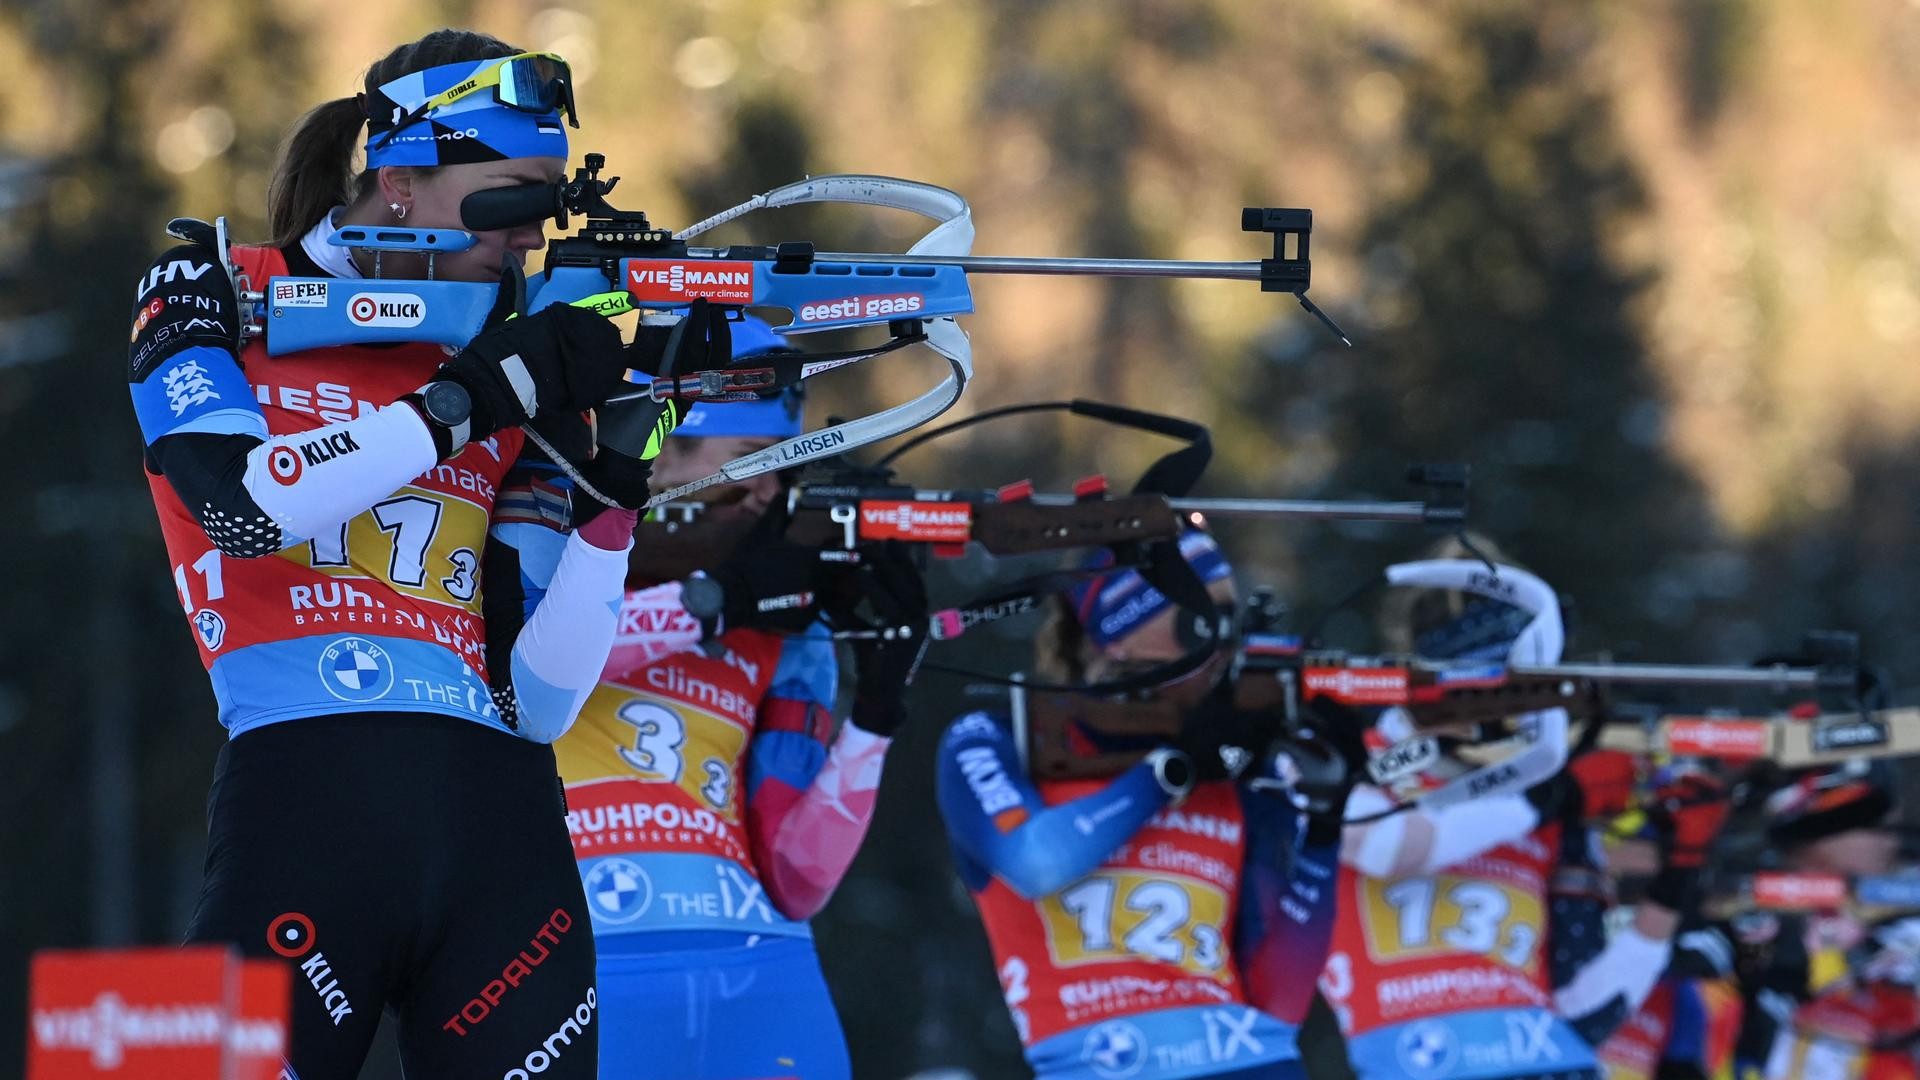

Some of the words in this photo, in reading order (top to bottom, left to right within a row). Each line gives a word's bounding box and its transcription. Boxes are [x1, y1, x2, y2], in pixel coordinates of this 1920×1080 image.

[138, 260, 213, 302] LHV
[296, 284, 326, 298] FEB
[631, 265, 749, 292] VIESSMANN
[685, 289, 697, 298] for
[700, 290, 714, 298] our
[717, 289, 749, 298] climate
[380, 303, 419, 318] KLICK
[801, 297, 860, 322] eesti
[865, 295, 920, 318] gaas
[299, 430, 360, 467] KLICK
[781, 430, 845, 461] LARSEN
[864, 505, 970, 531] VIESSMANN
[174, 548, 224, 615] 11
[441, 548, 480, 604] 3
[326, 640, 382, 661] BMW
[404, 679, 463, 708] THE
[615, 700, 686, 785] 3
[702, 759, 731, 809] 3
[660, 892, 719, 917] THE
[1382, 878, 1510, 953] 13
[1061, 877, 1190, 963] 12
[1191, 923, 1222, 970] 3
[300, 951, 353, 1026] KLICK
[443, 907, 573, 1037] TOPAUTO
[1002, 955, 1031, 1009] 2
